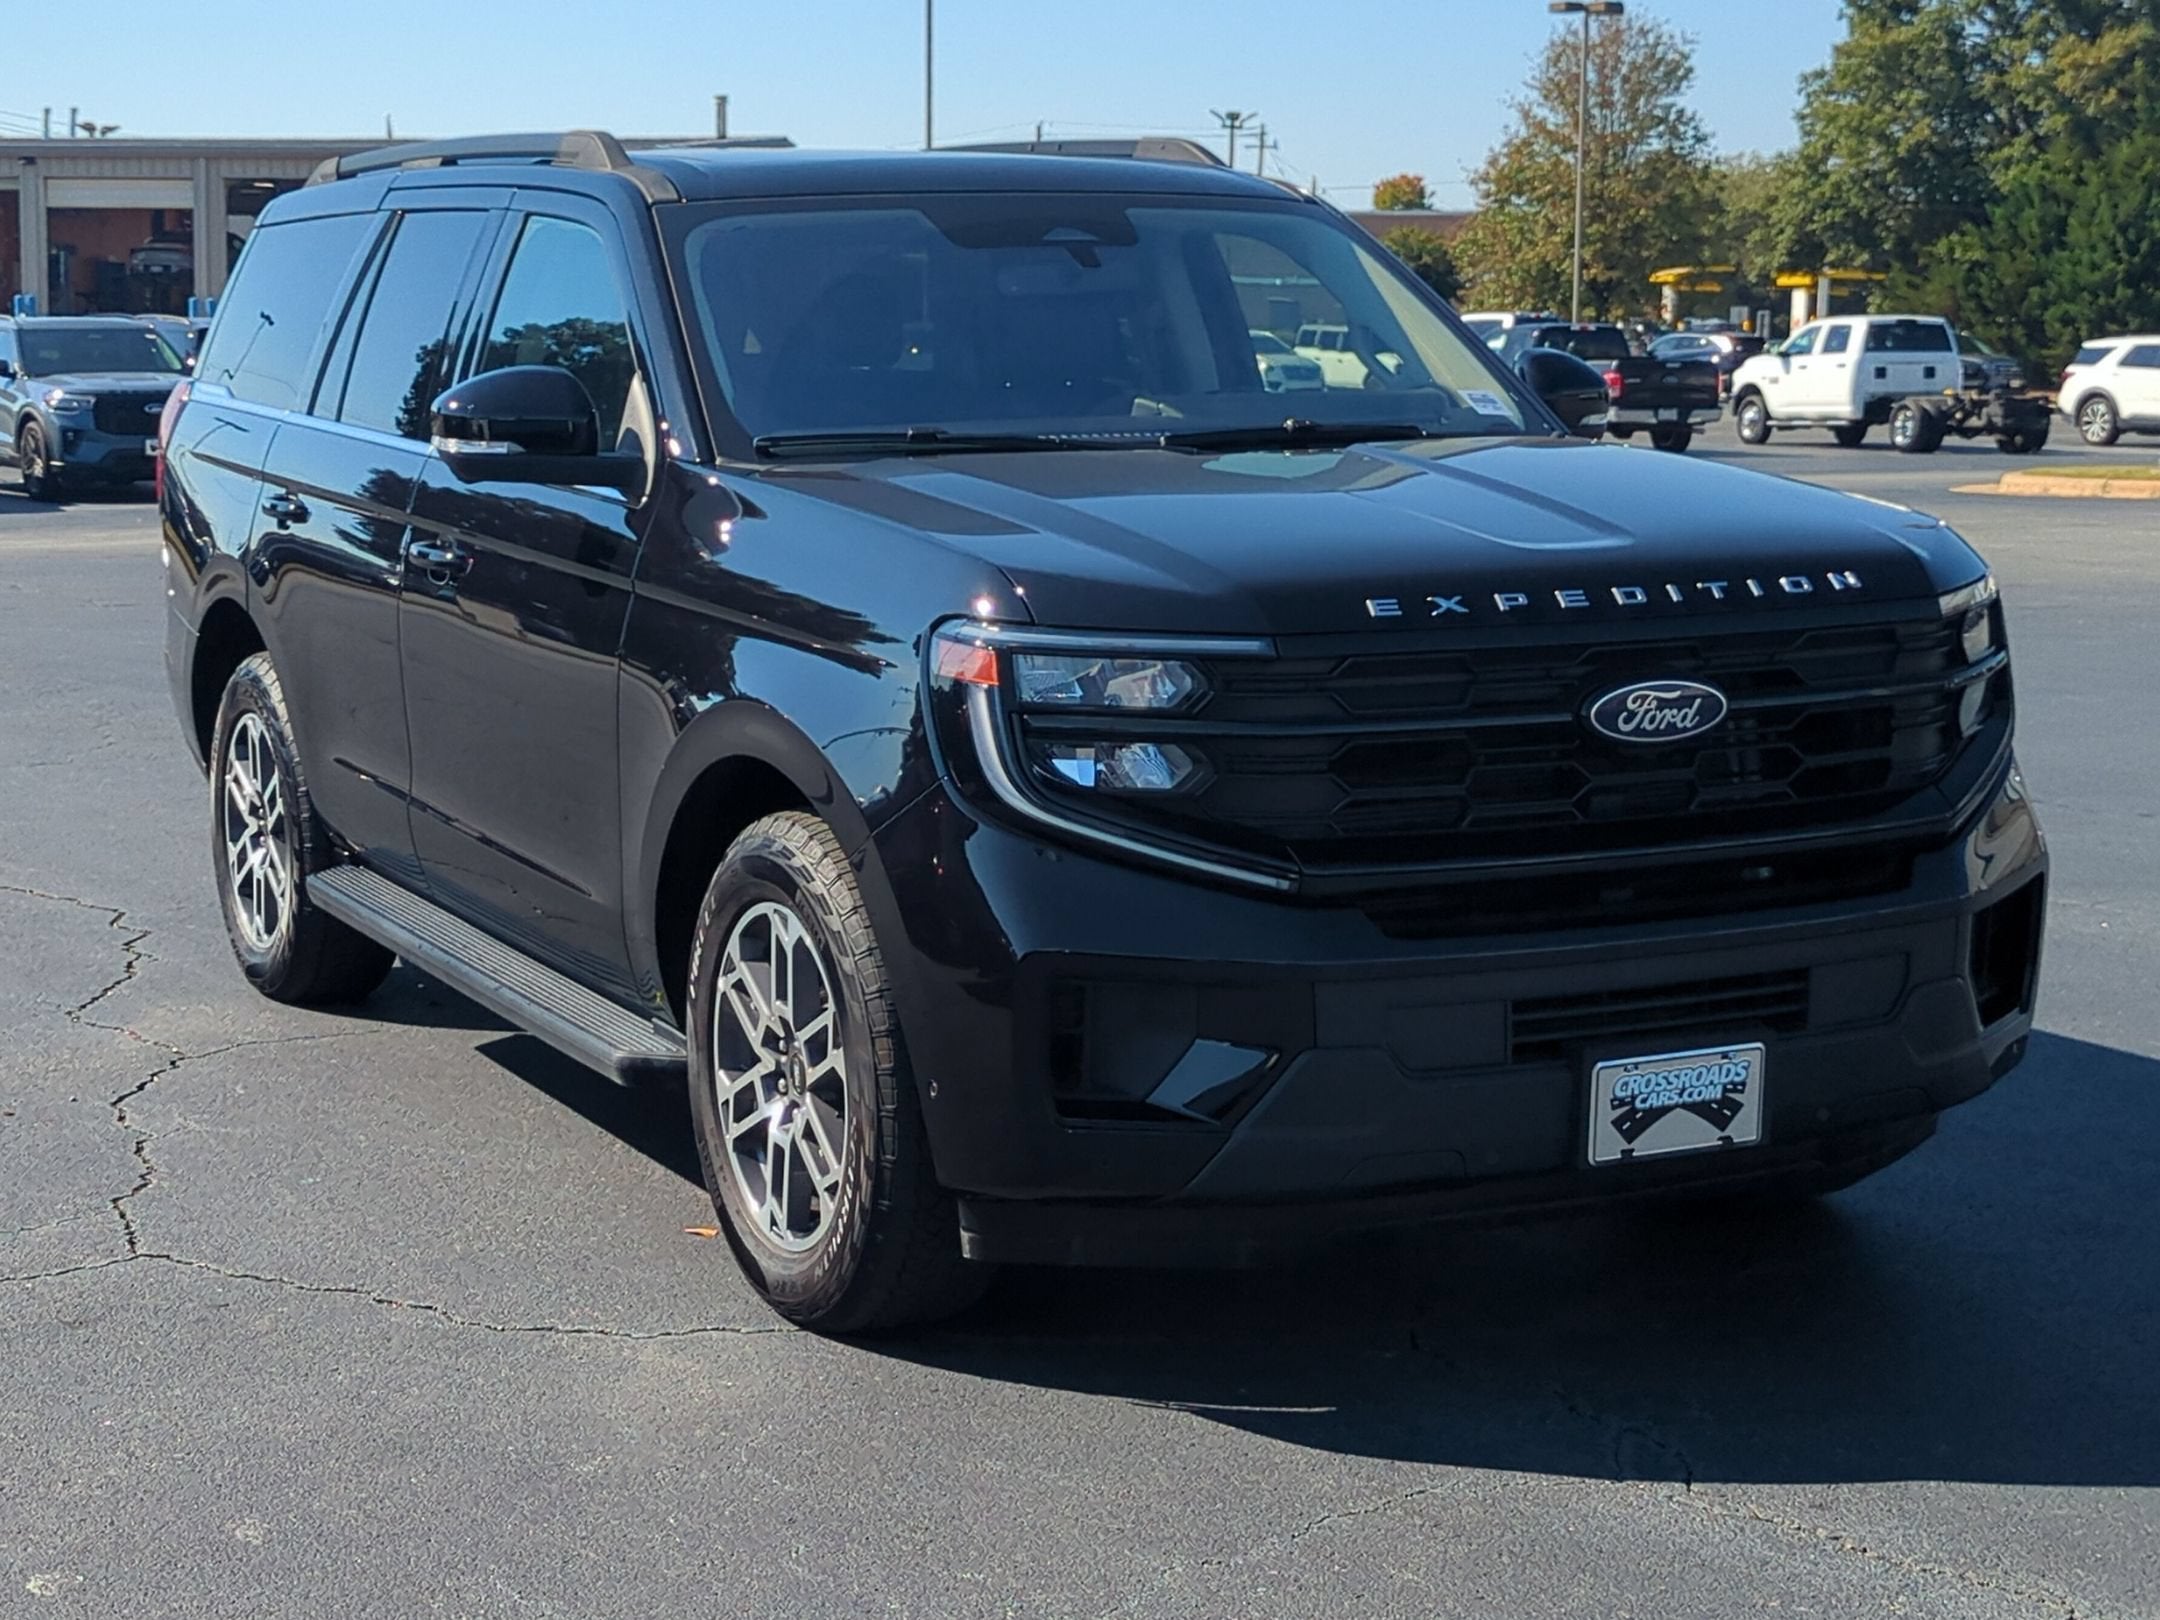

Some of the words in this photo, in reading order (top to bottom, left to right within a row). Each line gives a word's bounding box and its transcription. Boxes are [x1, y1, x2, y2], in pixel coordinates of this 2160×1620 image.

[1365, 571, 1863, 617] EXPEDITION
[1617, 690, 1702, 732] Ford
[1614, 1060, 1750, 1099] CROSSROADS
[1635, 1084, 1723, 1110] CARS.COM
